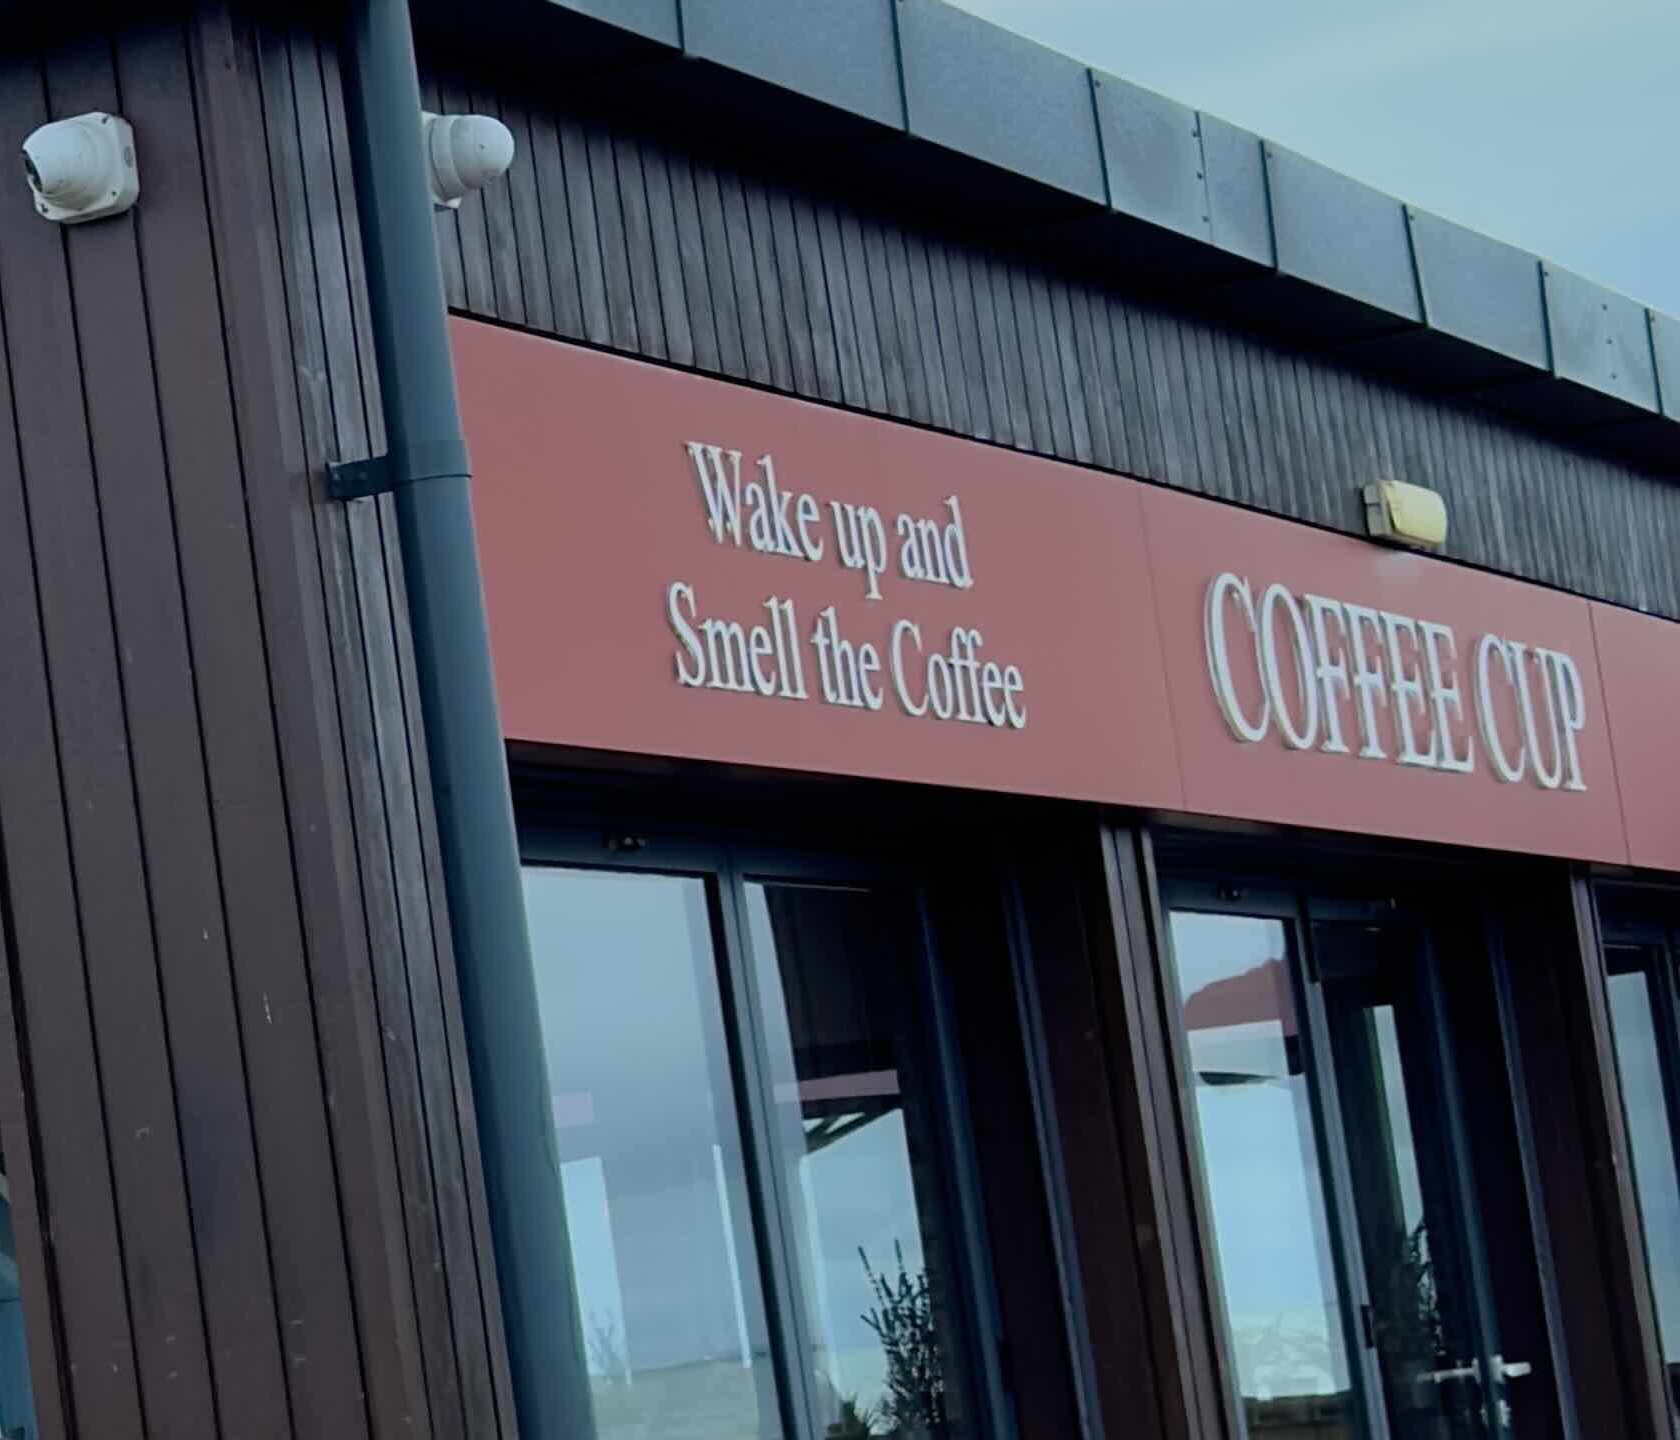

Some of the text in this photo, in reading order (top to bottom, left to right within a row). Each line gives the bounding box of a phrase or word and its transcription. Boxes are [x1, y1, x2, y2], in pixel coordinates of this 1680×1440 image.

[686, 440, 976, 601] Wake up and
[667, 581, 1028, 731] Smell the Coffee
[1203, 570, 1590, 794] COFFEE CUP
